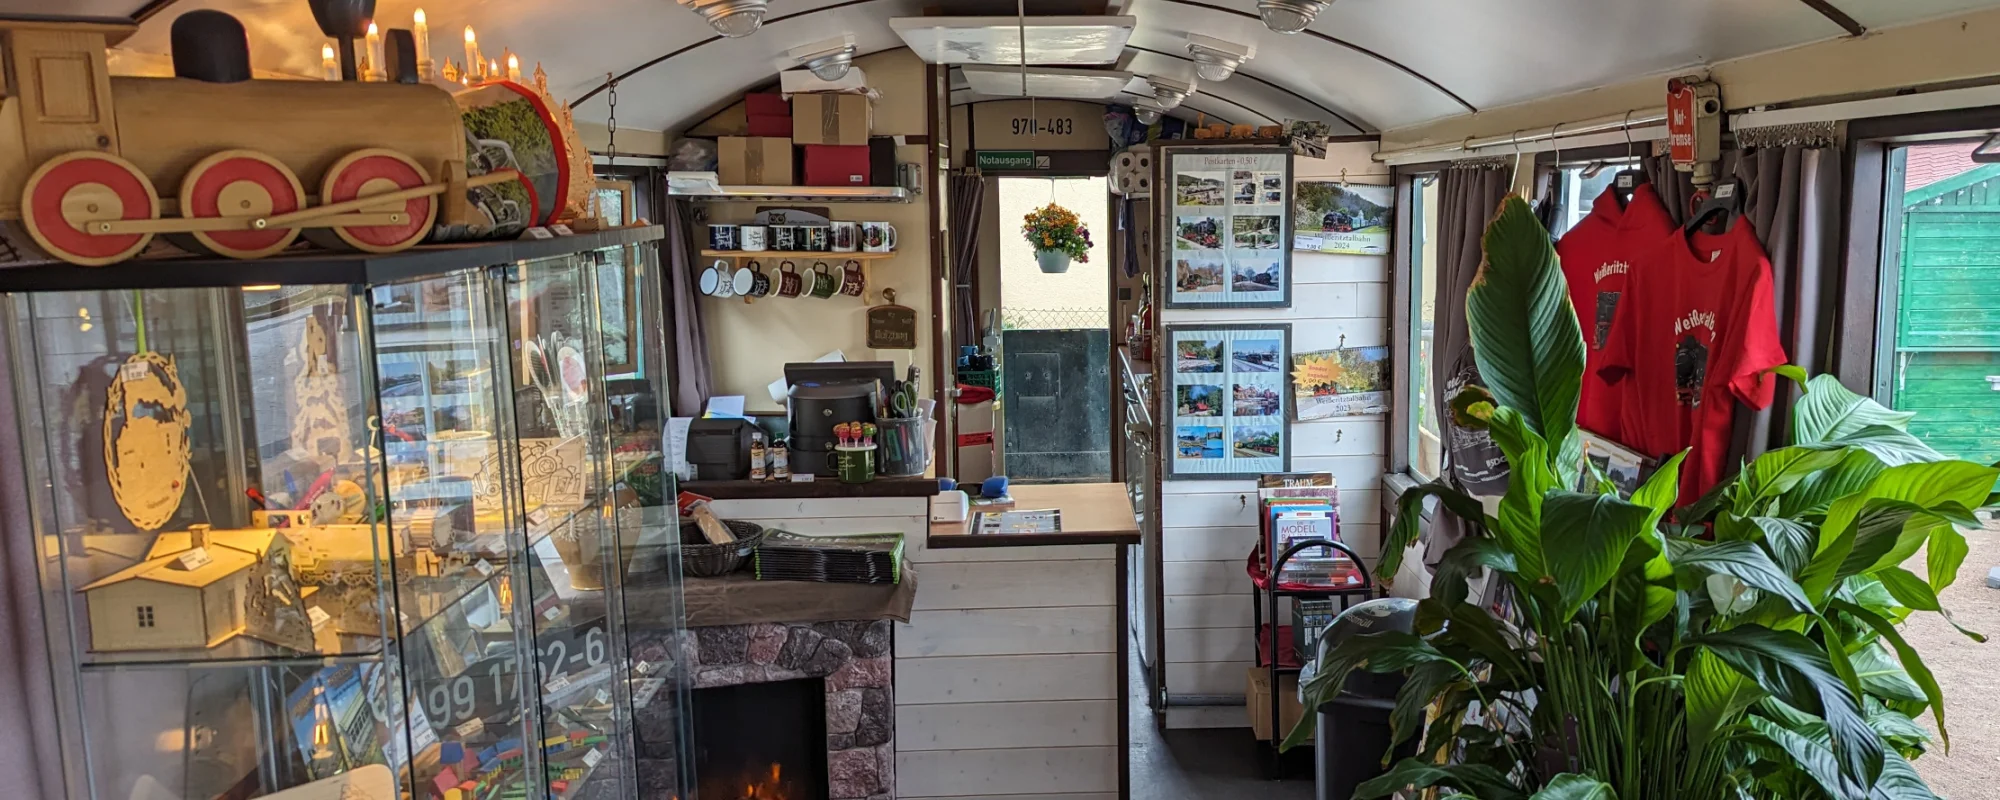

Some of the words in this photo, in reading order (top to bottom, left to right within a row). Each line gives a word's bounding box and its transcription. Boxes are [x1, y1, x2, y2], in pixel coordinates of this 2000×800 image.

[1673, 108, 1687, 125] Not-
[1012, 118, 1073, 135] 970-483
[979, 155, 1032, 167] Notausgang
[1204, 156, 1236, 165] Postkarten
[1240, 156, 1253, 166] 0,50
[1253, 156, 1258, 165] €
[1283, 478, 1314, 487] TRAUM
[1281, 525, 1317, 533] MODELL
[428, 674, 476, 730] 99
